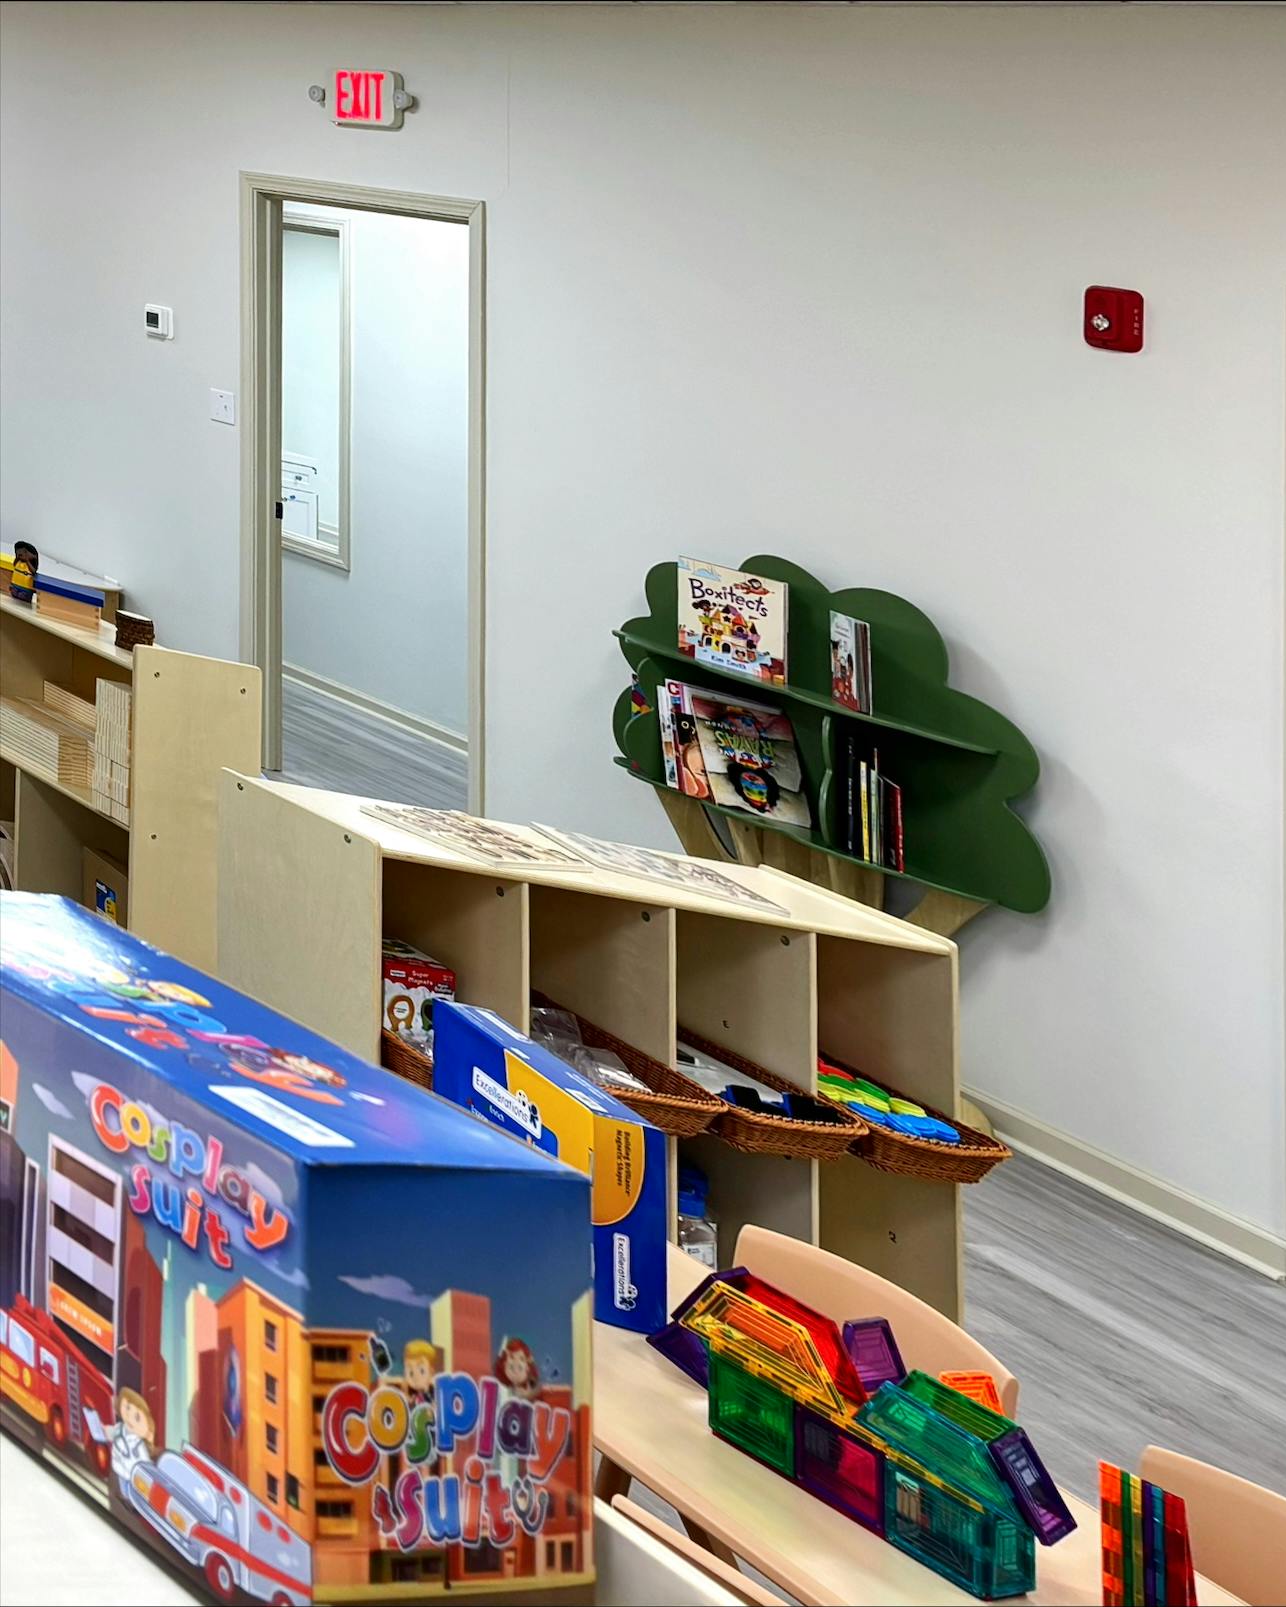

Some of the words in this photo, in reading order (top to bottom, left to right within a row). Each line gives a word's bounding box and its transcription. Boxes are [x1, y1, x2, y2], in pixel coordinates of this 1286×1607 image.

[336, 70, 385, 121] EXIT
[688, 577, 768, 617] Boxitects
[476, 1074, 528, 1122] Excellerations
[90, 1083, 288, 1250] Cosplay
[129, 1164, 233, 1269] suit
[617, 1236, 627, 1295] Excellerations
[322, 1373, 570, 1486] Cosplay
[396, 1456, 515, 1552] suit
